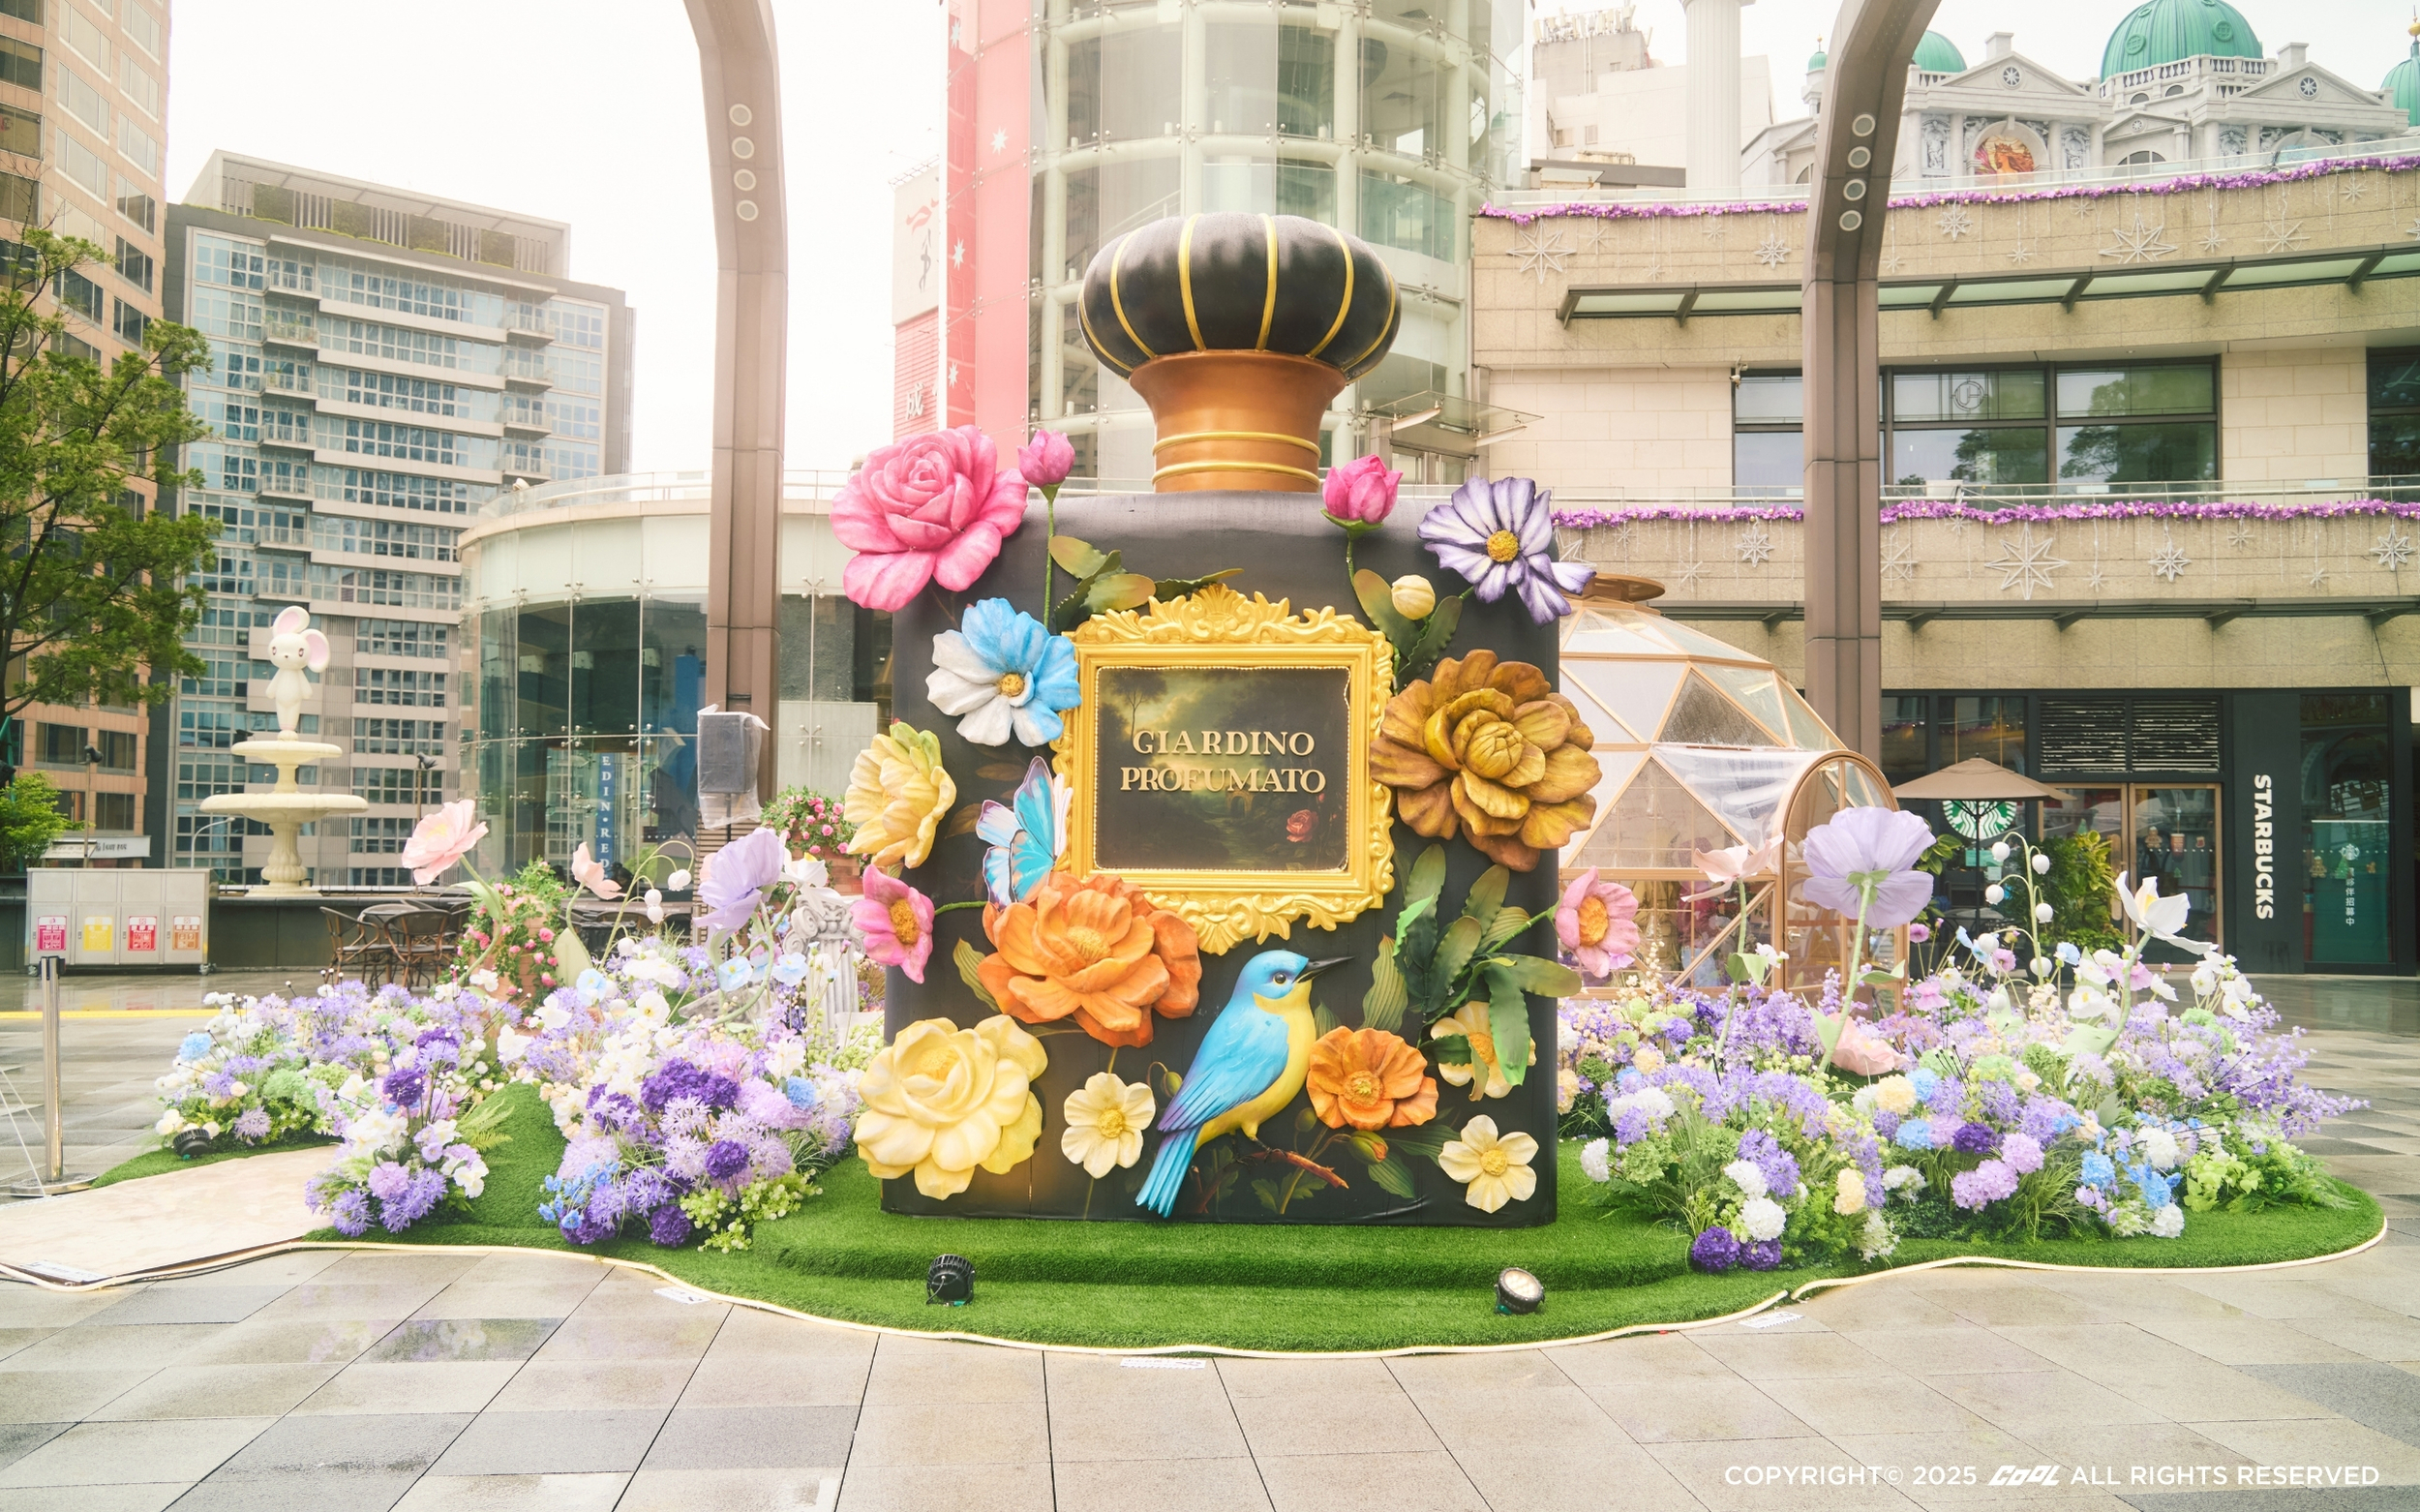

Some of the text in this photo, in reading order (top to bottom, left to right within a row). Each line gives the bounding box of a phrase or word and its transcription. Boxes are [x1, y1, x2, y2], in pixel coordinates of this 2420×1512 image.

[1133, 731, 1315, 755] GIARDINO
[1120, 767, 1326, 794] PROFUMATO
[2254, 774, 2274, 920] STARBUCKS
